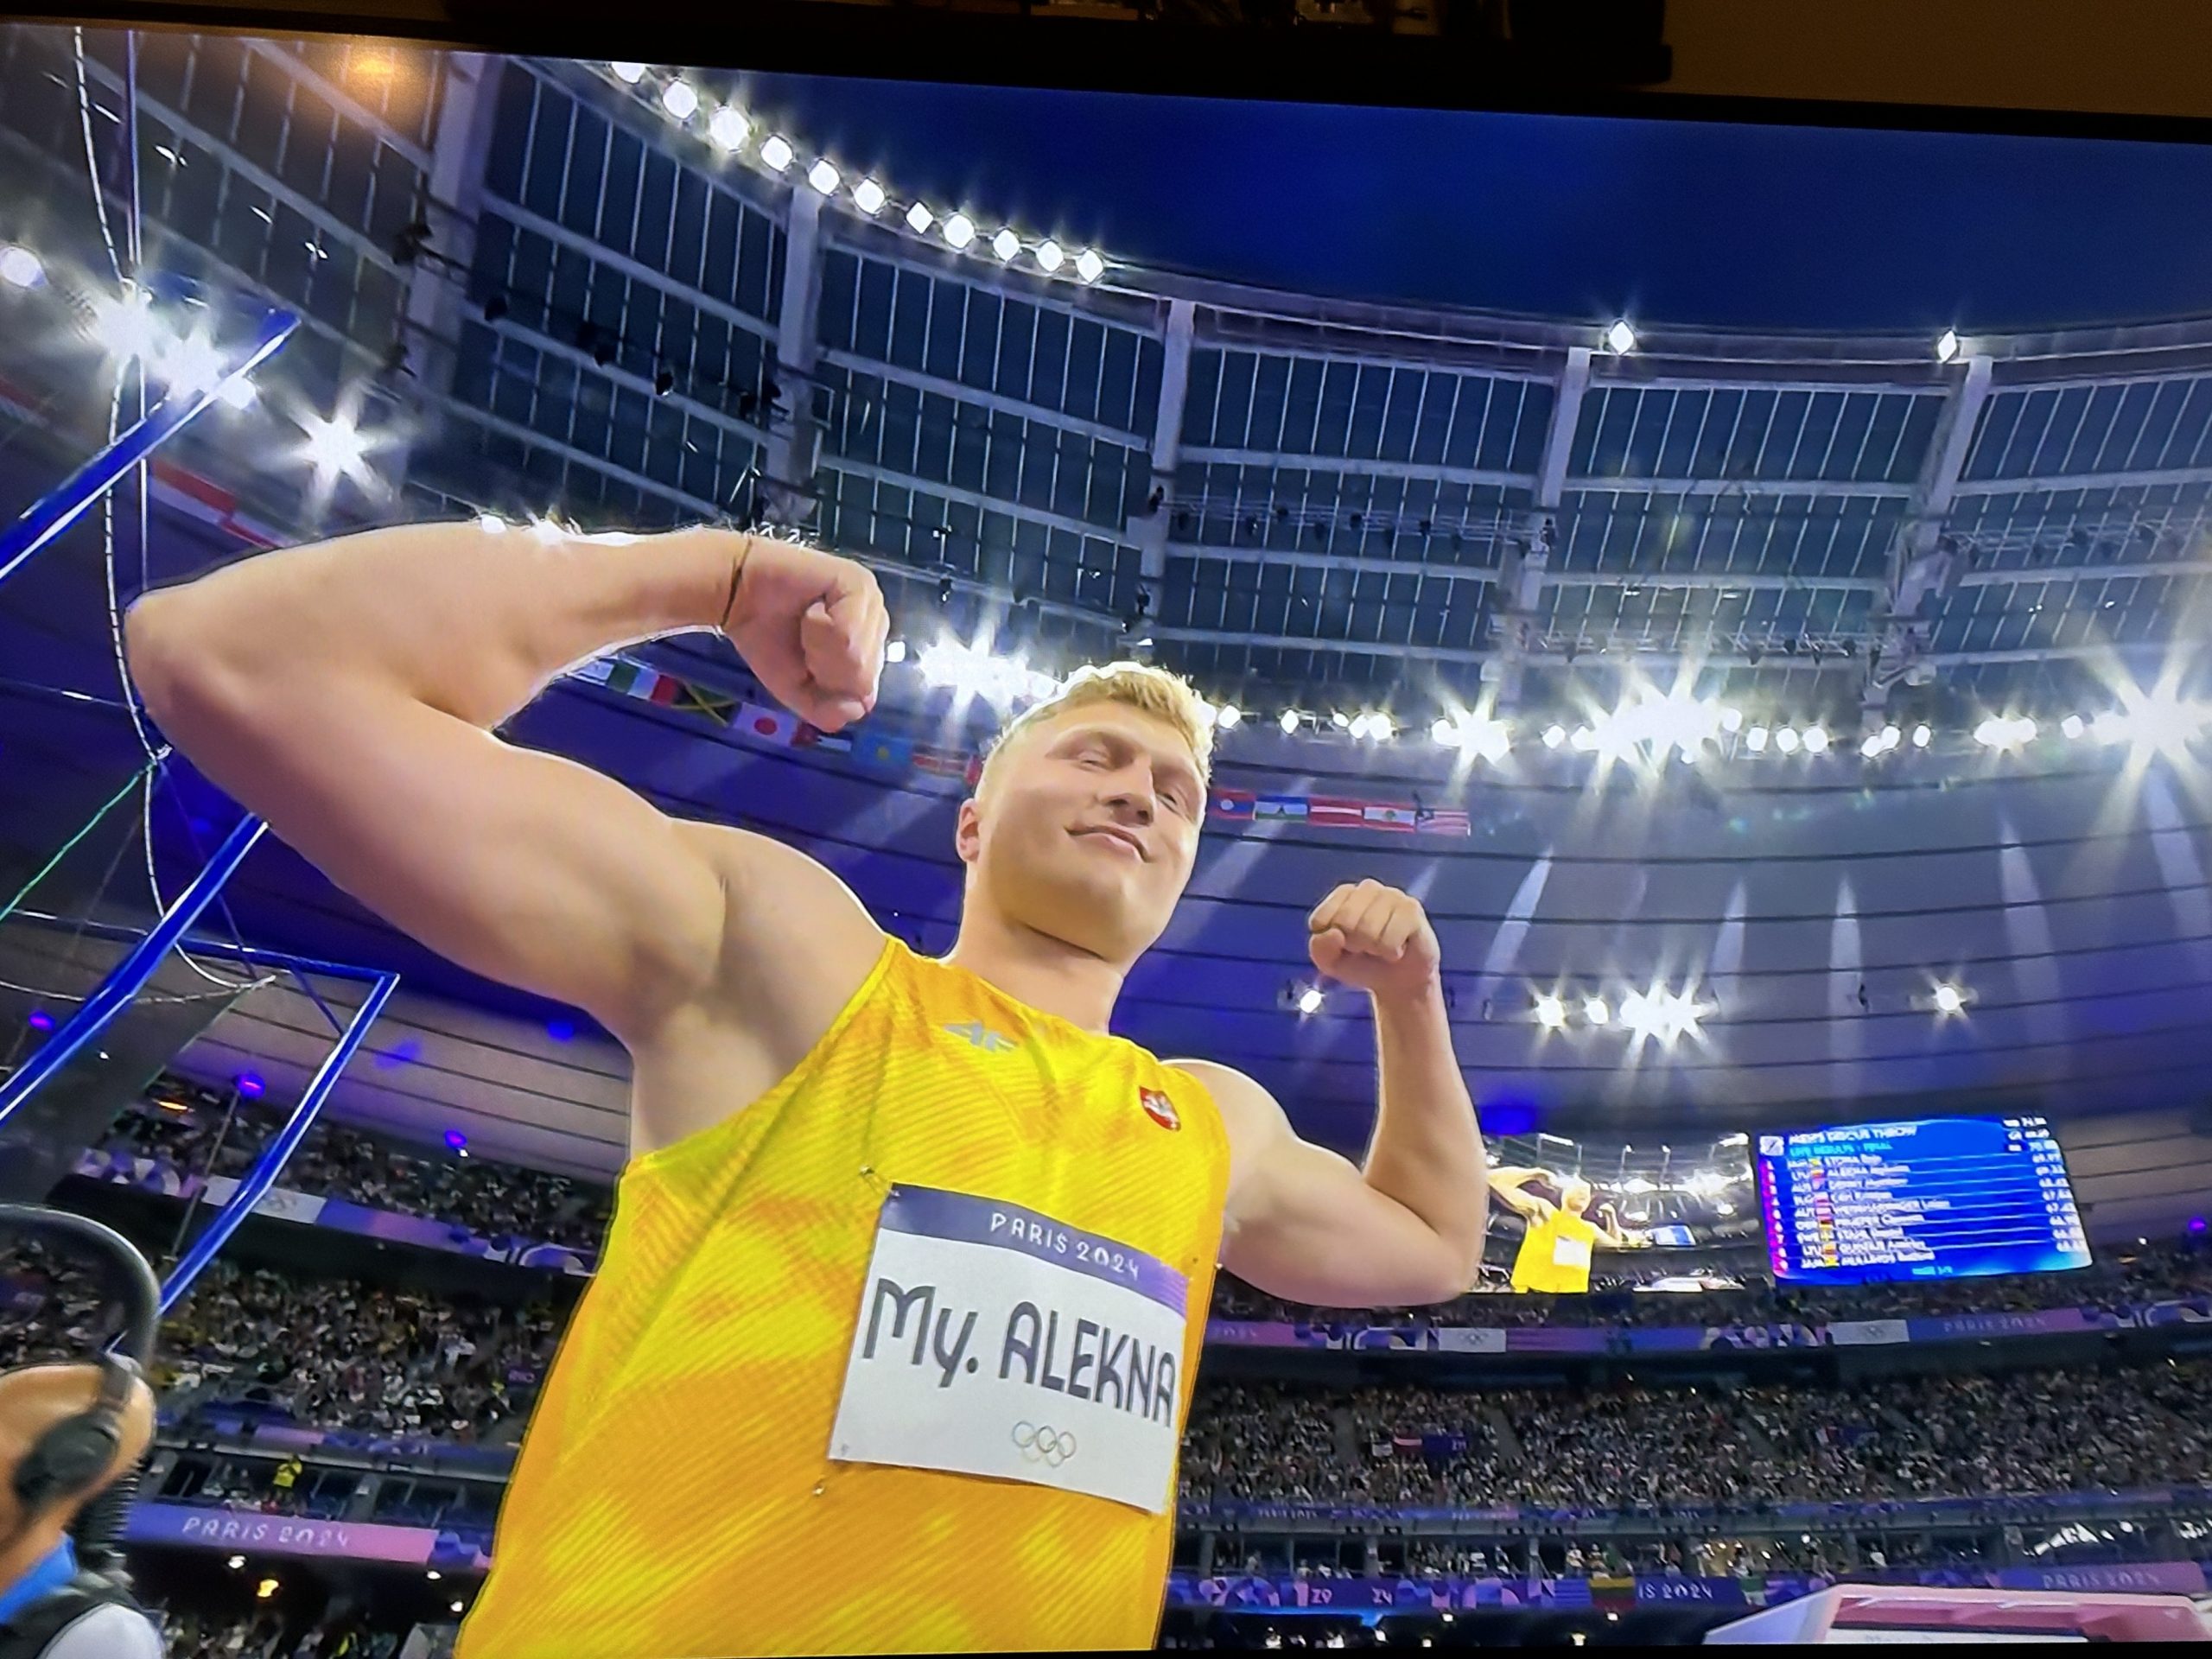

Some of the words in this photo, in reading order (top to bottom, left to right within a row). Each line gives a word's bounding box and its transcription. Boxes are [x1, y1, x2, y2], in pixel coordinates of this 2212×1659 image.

[989, 1212, 1067, 1255] PARIS
[1075, 1241, 1140, 1280] 2024
[861, 1277, 979, 1389] My.
[998, 1300, 1176, 1427] ALEKNA
[182, 1516, 268, 1541] PARIS
[278, 1525, 348, 1548] 2024
[2043, 1573, 2101, 1590] PARIS
